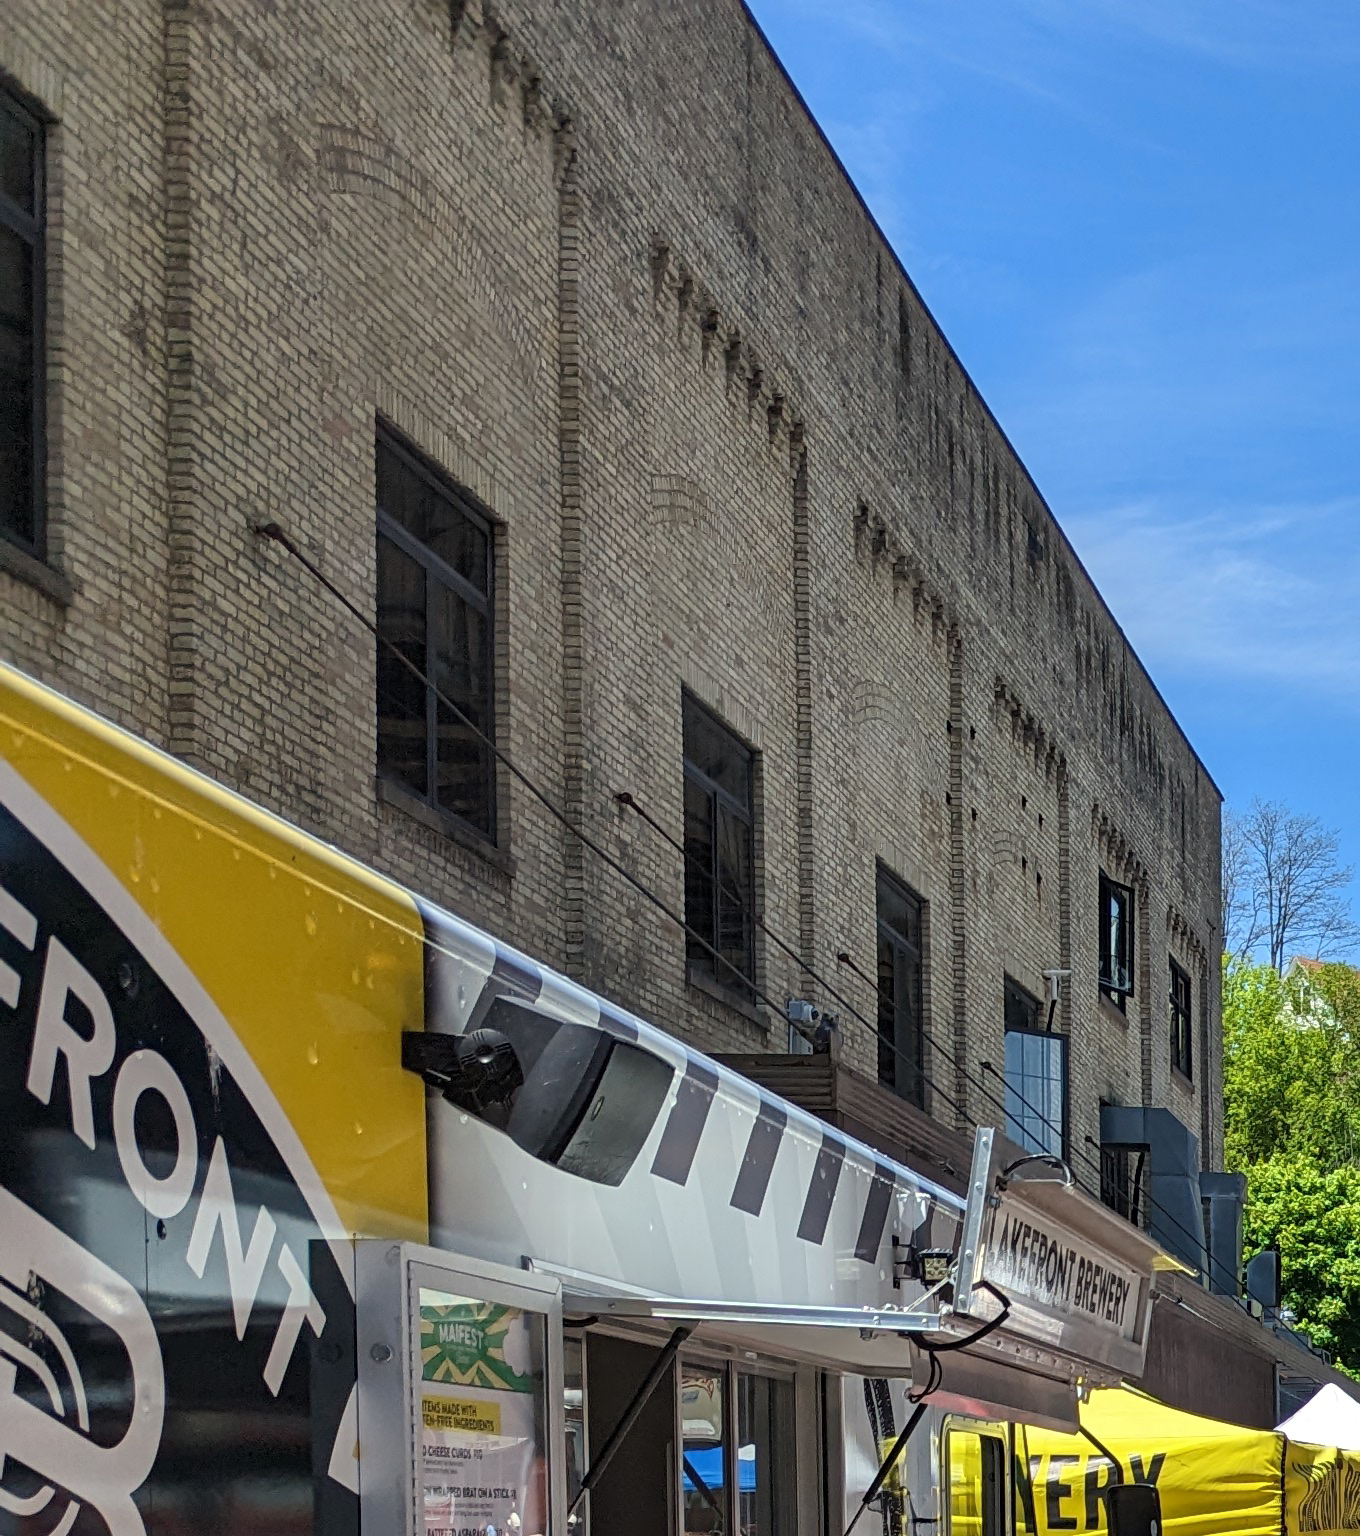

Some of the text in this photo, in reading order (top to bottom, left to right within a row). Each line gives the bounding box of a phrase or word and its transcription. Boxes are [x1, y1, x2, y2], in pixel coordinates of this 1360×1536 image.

[985, 1212, 1130, 1326] LAKEFRONT BREWERY
[439, 1323, 484, 1350] MAIFEST
[442, 1403, 460, 1416] MADE
[461, 1405, 477, 1417] WITH
[454, 1417, 494, 1432] INGREDIENTS
[427, 1446, 450, 1458] CHEESE
[451, 1447, 471, 1459] CURDS
[493, 1489, 509, 1500] STICK
